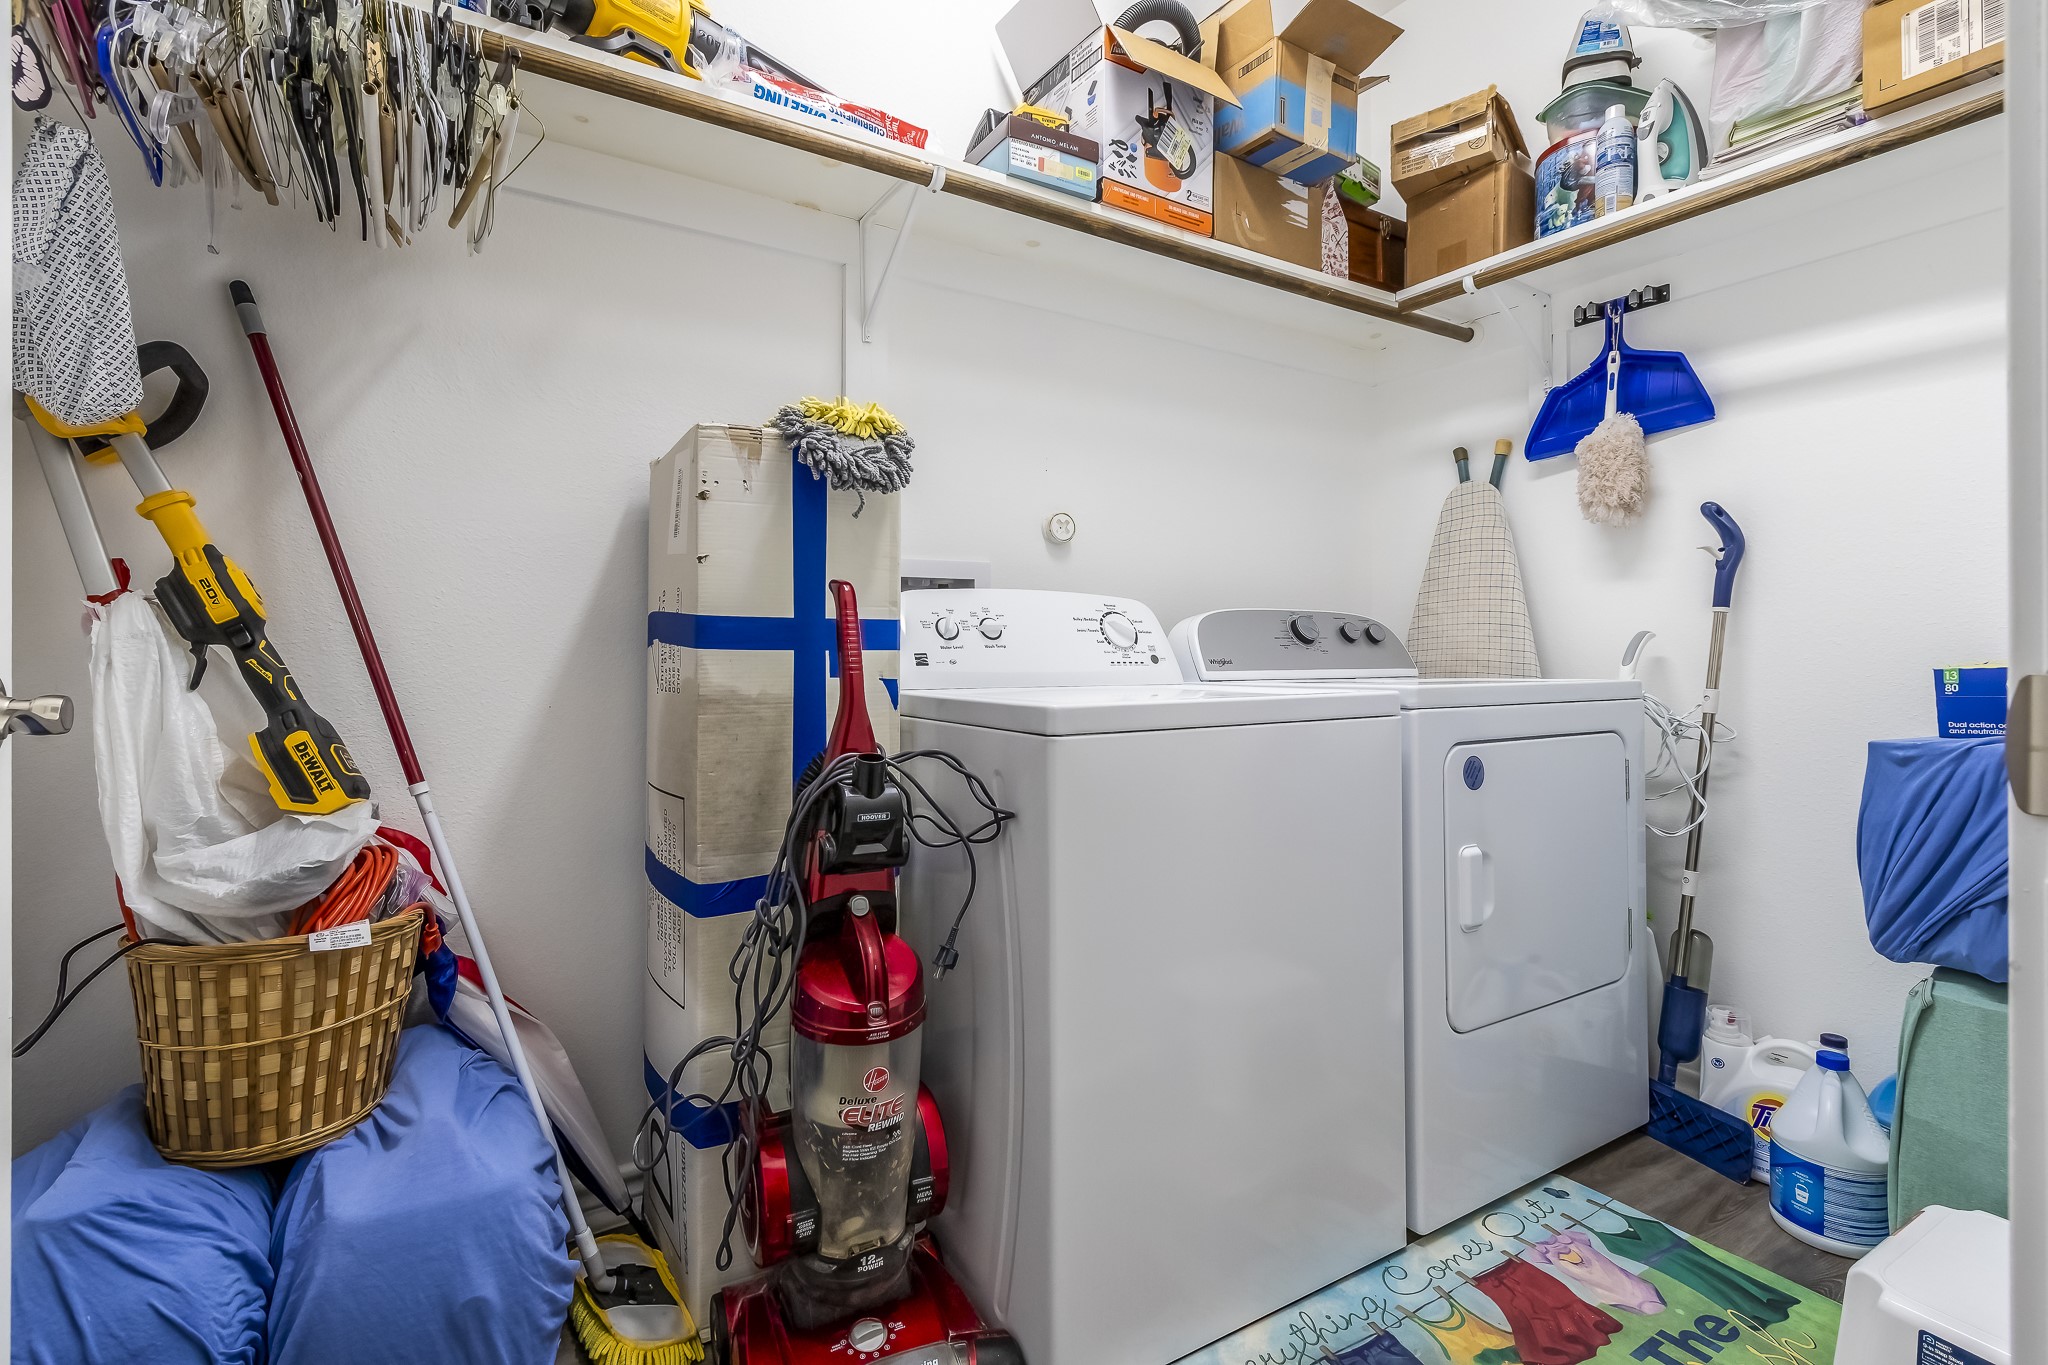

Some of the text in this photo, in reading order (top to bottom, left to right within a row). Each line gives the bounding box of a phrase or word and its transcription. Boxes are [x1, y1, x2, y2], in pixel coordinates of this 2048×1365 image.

[1030, 133, 1057, 145] ANTONIO
[1944, 671, 1958, 681] 13
[1944, 684, 1959, 692] 80
[1969, 721, 1996, 729] action
[860, 813, 887, 821] HOOVER
[839, 1096, 878, 1105] Deluxe
[841, 1093, 905, 1125] ELITE
[867, 1112, 905, 1132] REWIND
[1382, 1238, 1494, 1296] Comes
[1482, 1197, 1556, 1238] Out
[860, 1254, 876, 1266] 12
[857, 1261, 884, 1273] POWER
[1629, 1314, 1741, 1365] The
